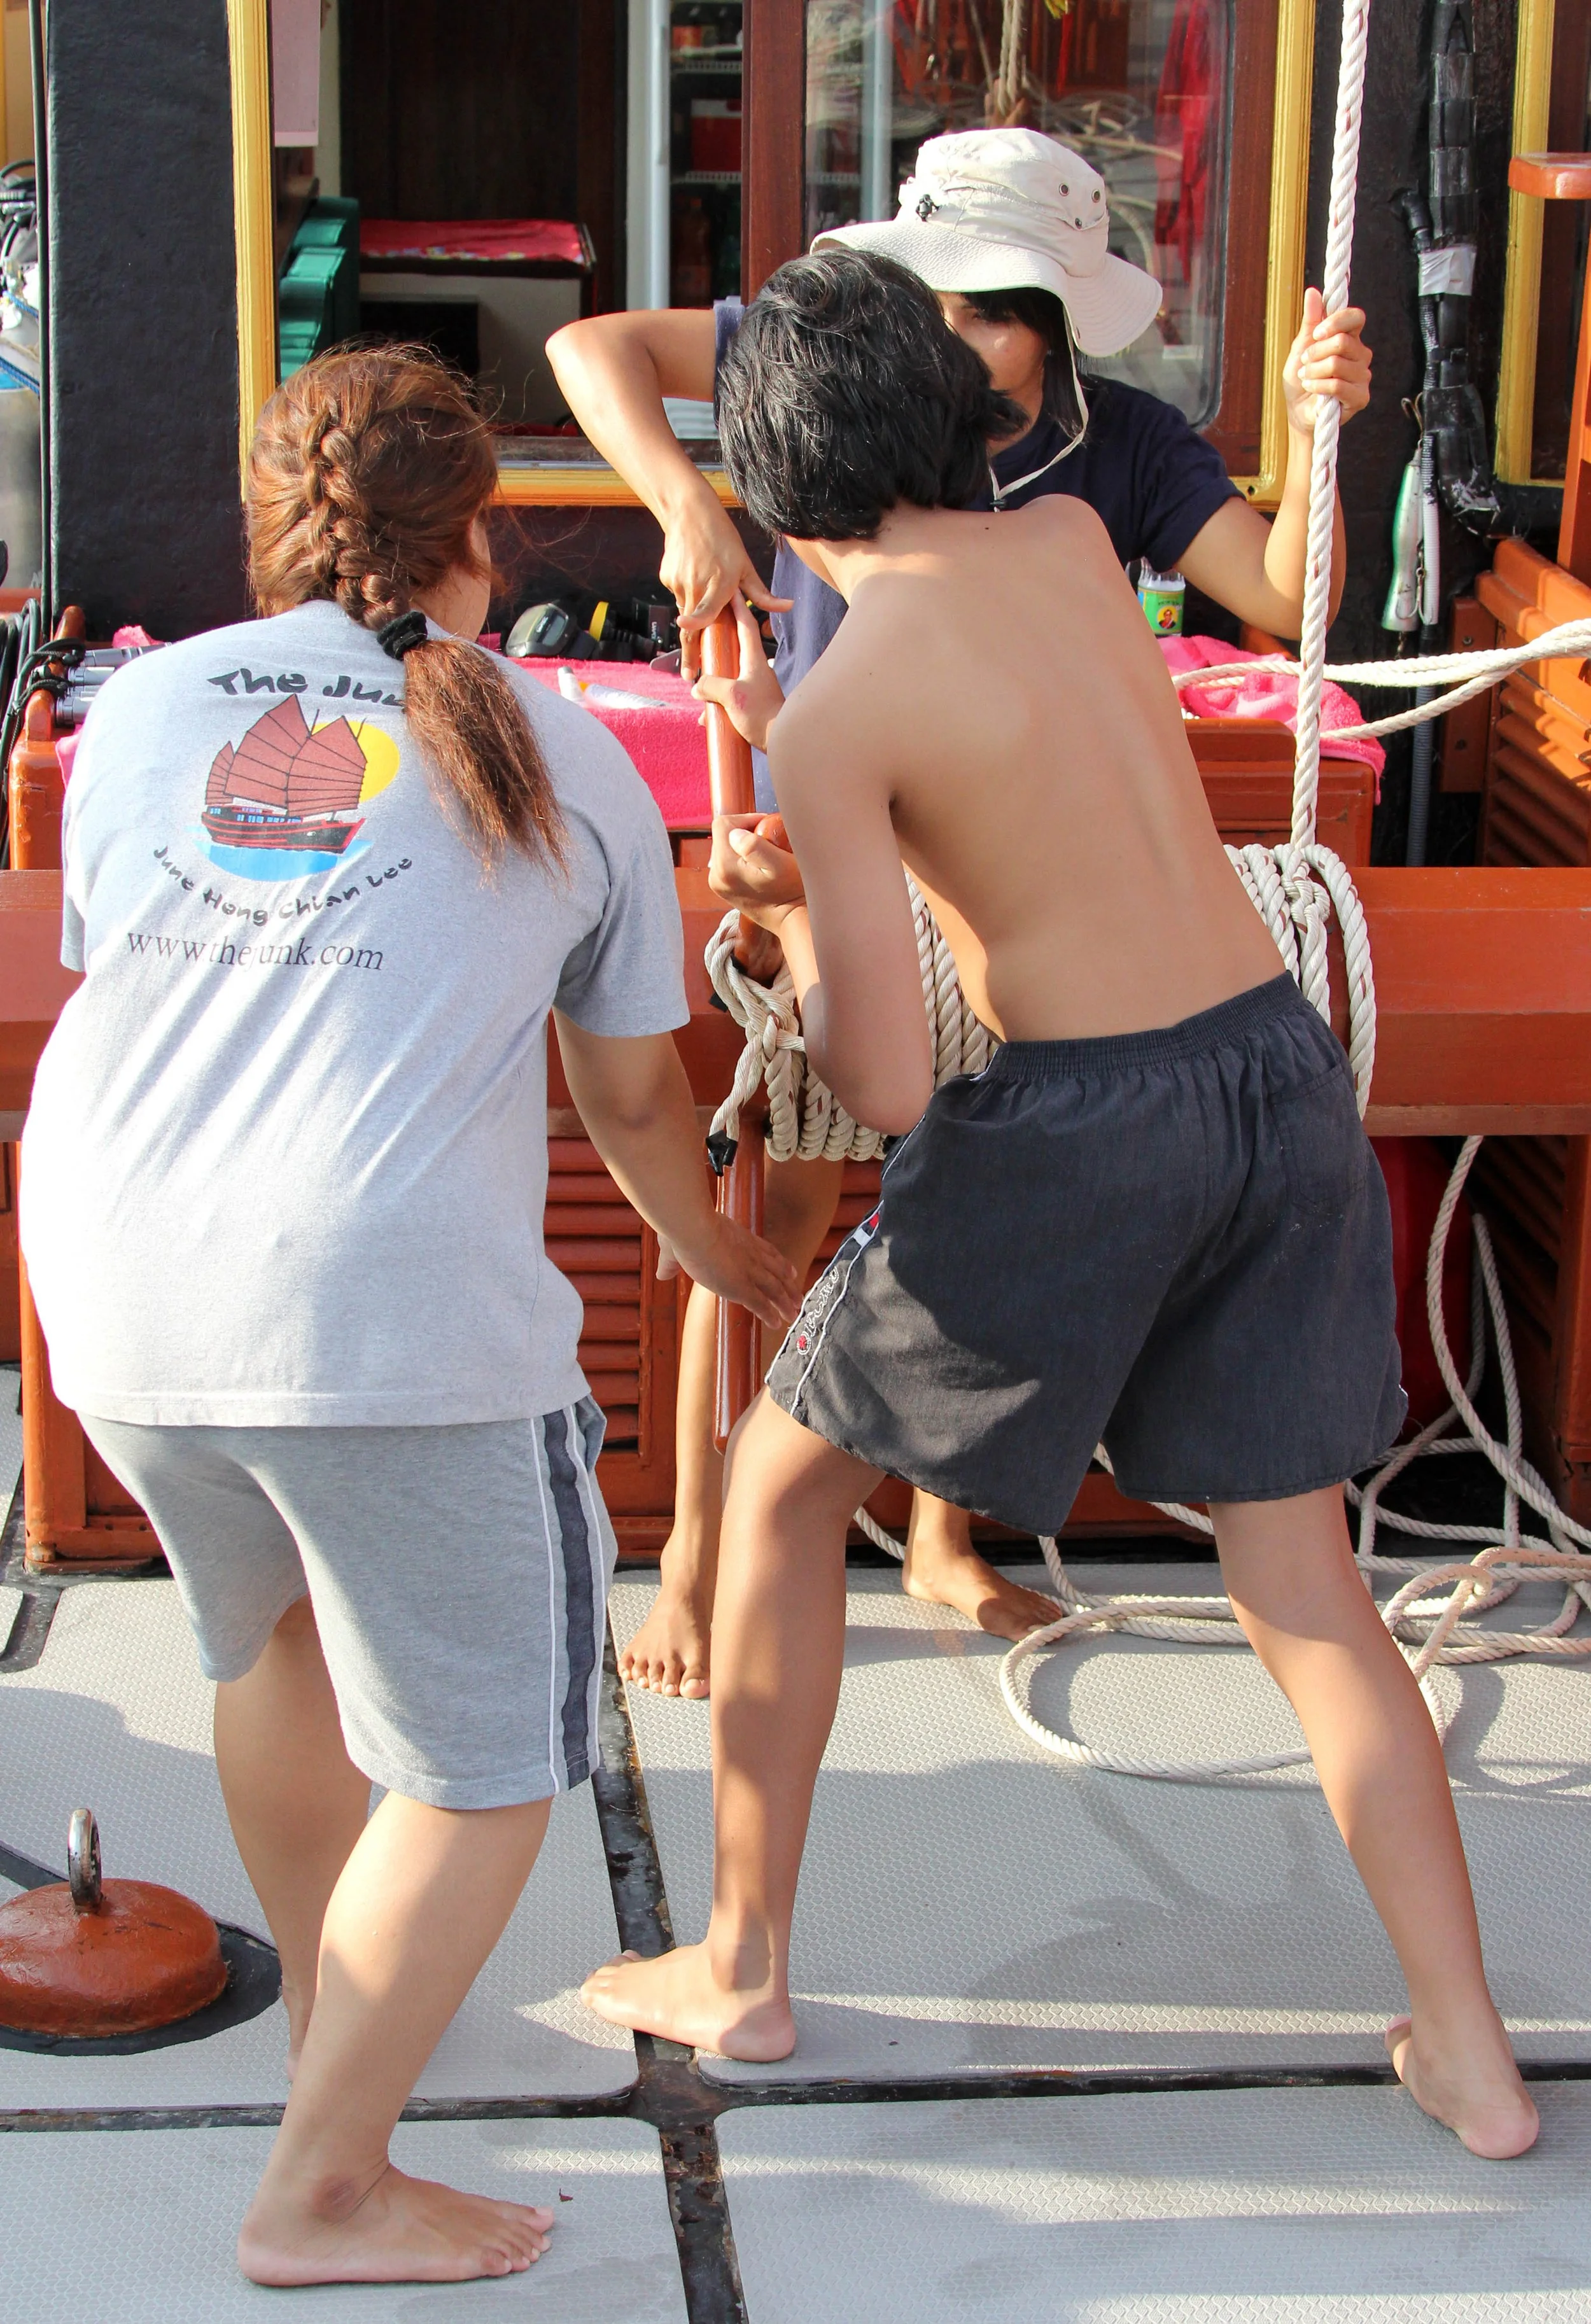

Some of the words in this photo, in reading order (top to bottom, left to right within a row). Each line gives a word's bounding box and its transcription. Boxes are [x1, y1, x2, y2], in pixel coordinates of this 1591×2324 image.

[207, 668, 309, 696] The
[322, 675, 407, 714] Jun
[153, 845, 195, 891] June
[202, 888, 268, 927] Hong
[278, 886, 360, 919] Chian
[366, 858, 412, 887] Lee
